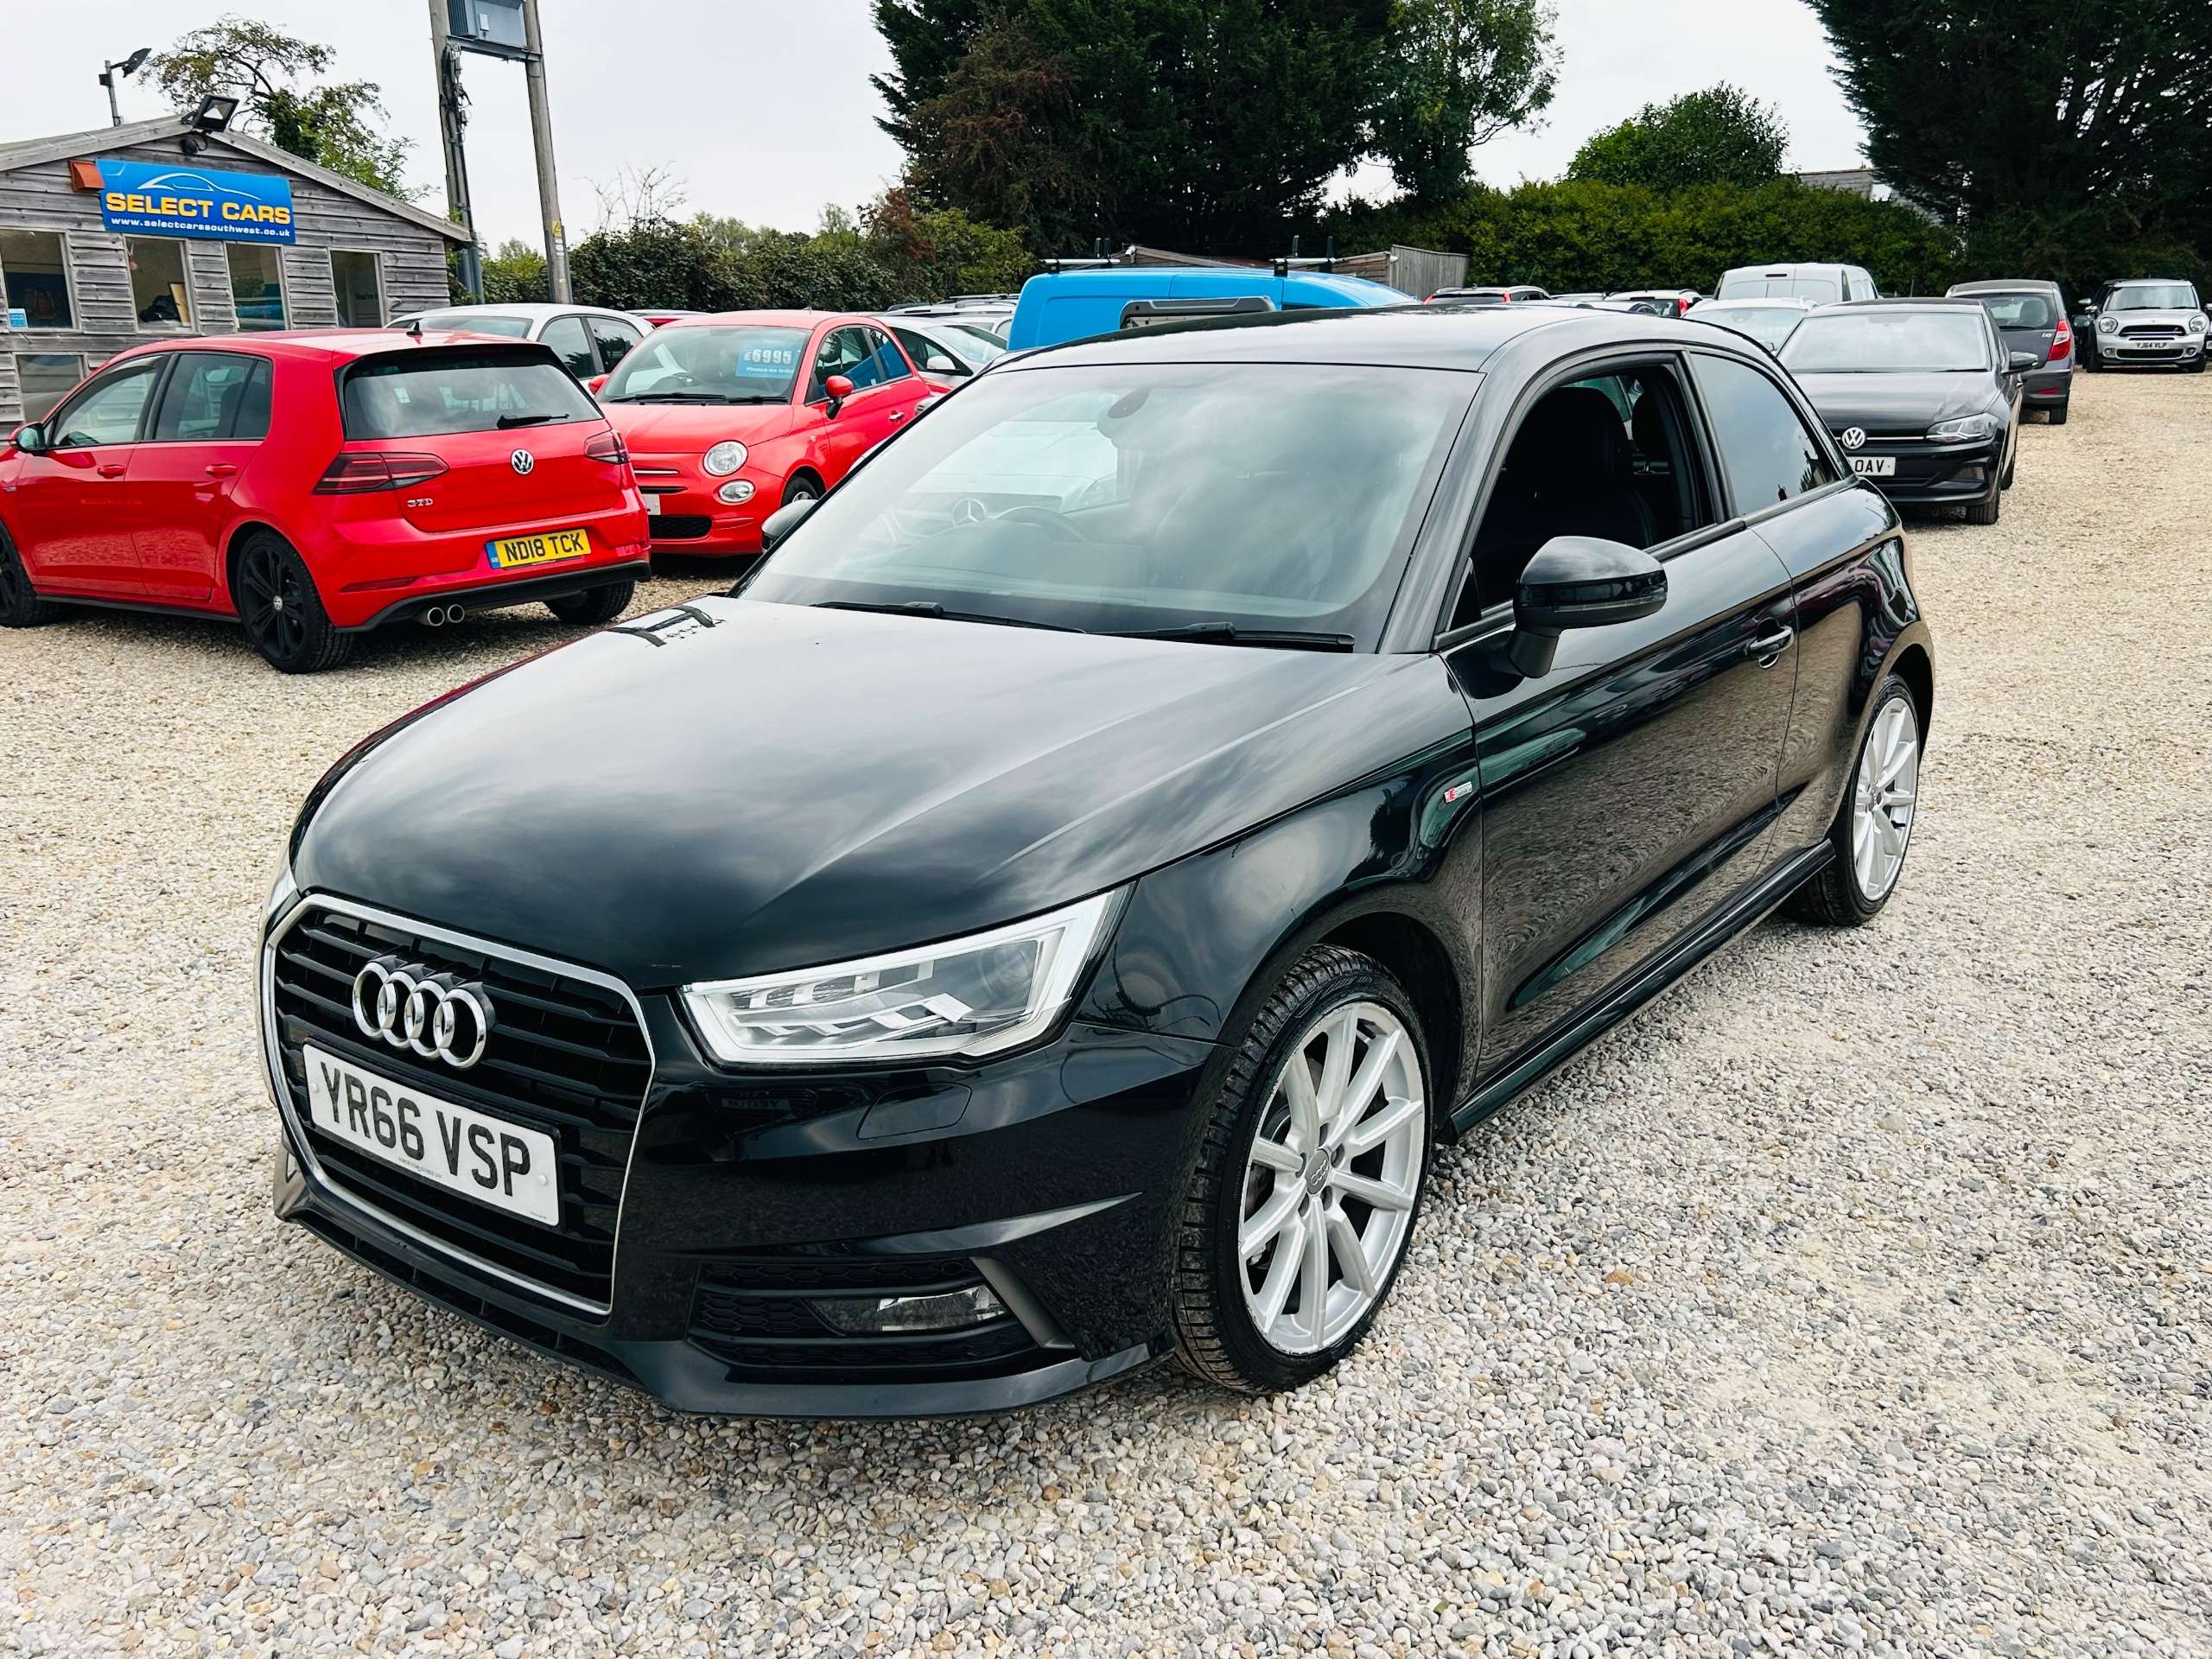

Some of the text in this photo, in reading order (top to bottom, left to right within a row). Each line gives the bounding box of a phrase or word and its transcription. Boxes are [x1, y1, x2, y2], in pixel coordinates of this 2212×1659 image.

[105, 193, 290, 225] SELECT CARS
[111, 217, 290, 237] www.selectcarssouthwest.co.uk
[407, 498, 434, 507] GTD
[504, 532, 584, 562] ND18 TCK
[321, 1061, 531, 1198] YR66 VSP
